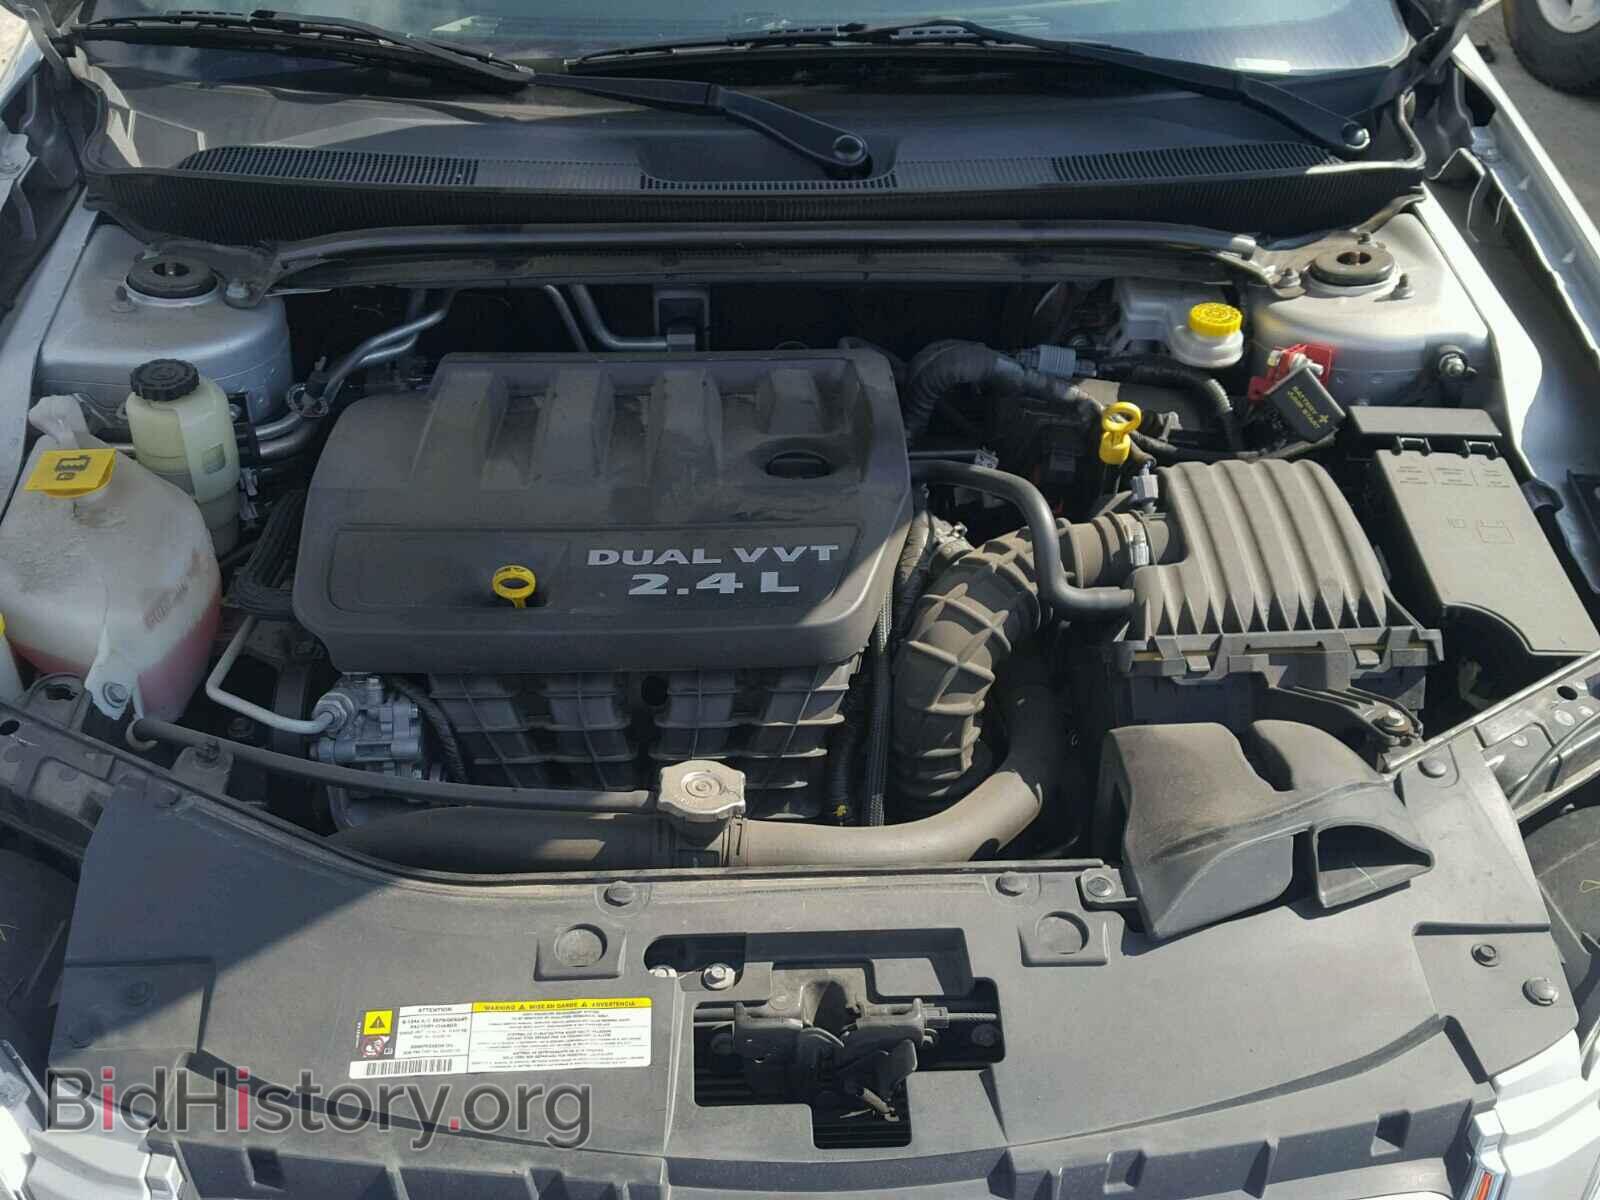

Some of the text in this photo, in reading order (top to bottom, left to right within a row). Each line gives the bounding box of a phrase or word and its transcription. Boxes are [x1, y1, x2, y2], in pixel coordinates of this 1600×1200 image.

[587, 545, 839, 566] DUAL VVT
[628, 571, 800, 595] 2.4 L
